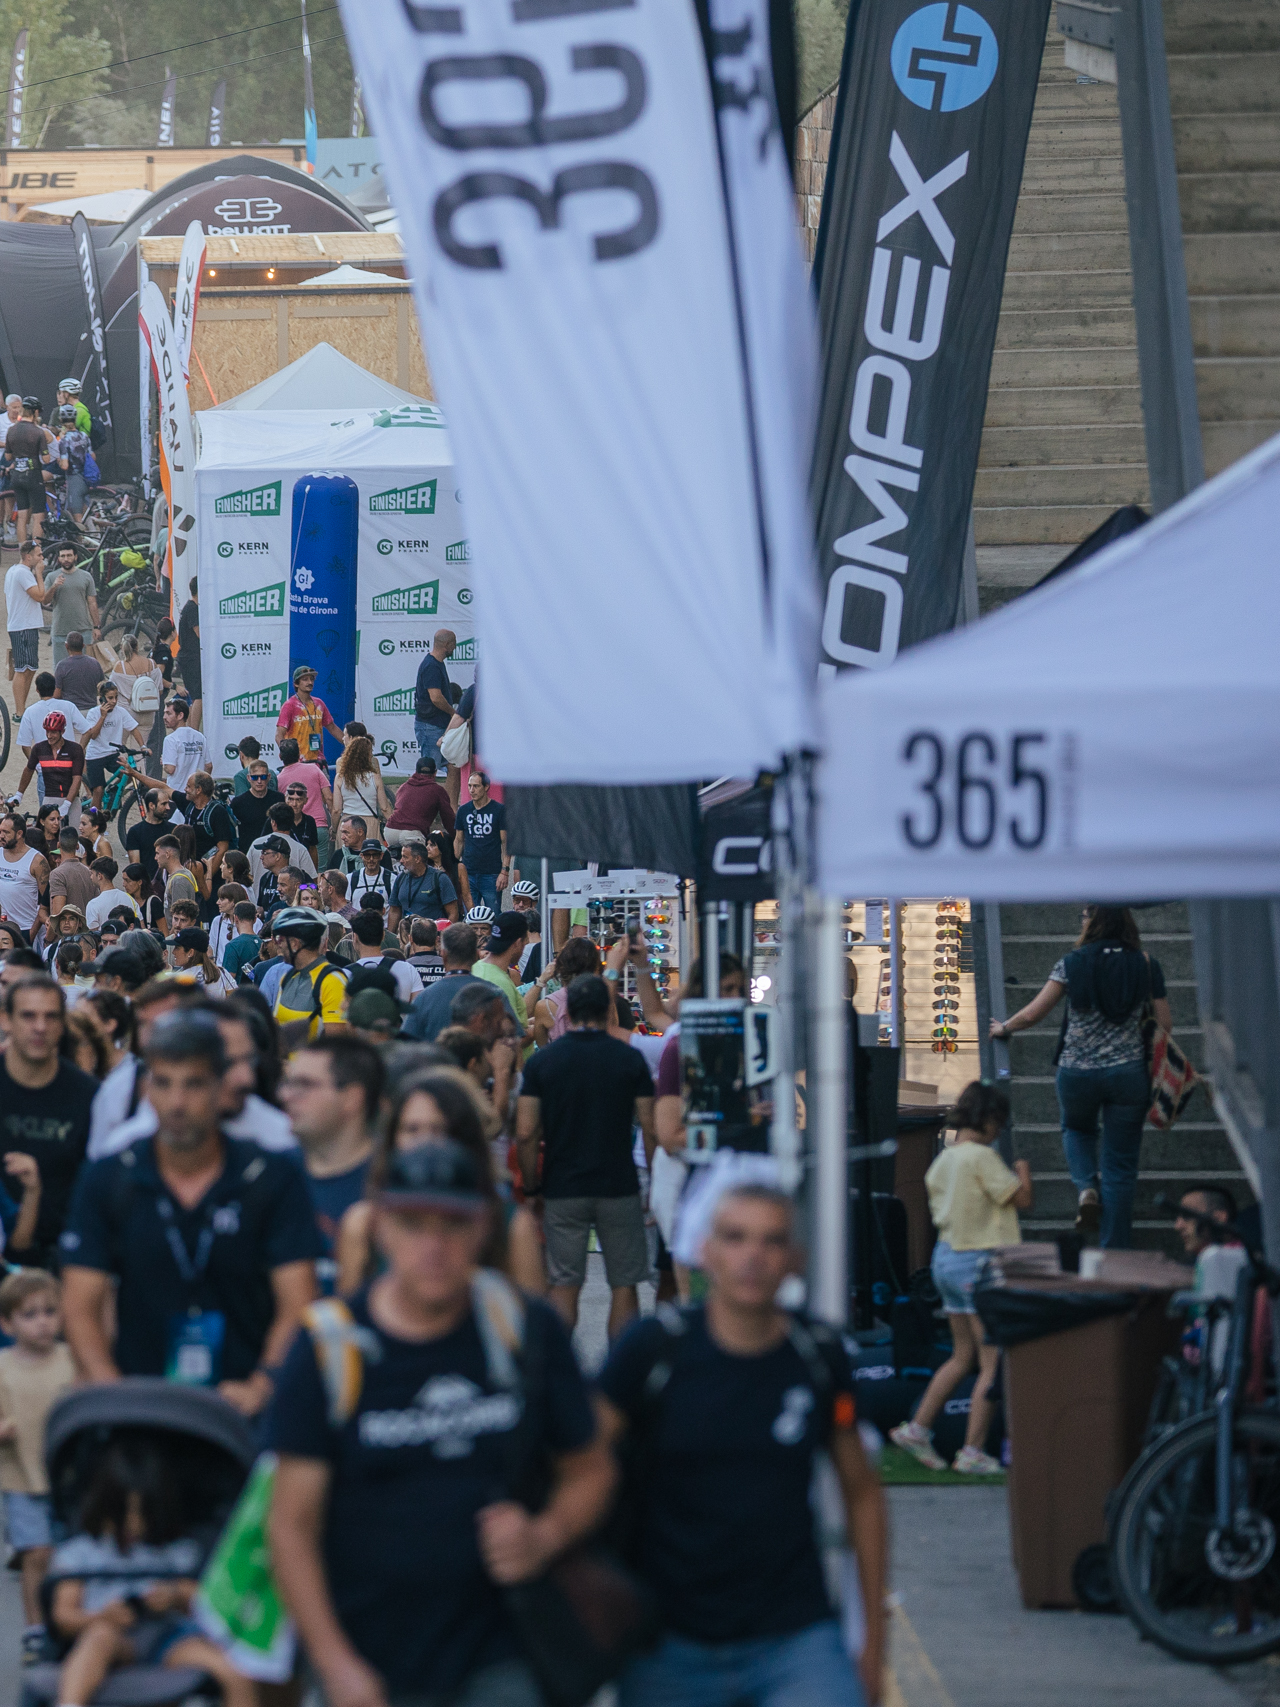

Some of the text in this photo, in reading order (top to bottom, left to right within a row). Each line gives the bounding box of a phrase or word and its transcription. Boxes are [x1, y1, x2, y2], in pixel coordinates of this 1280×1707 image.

[819, 130, 969, 678] OMPEX
[216, 487, 278, 513] FINISHER
[371, 486, 432, 511] FINISHER
[238, 542, 269, 550] KERN
[398, 540, 429, 548] KERN
[220, 588, 281, 614] FINISHER
[303, 594, 328, 604] Brava
[373, 586, 434, 611] FINISHER
[309, 606, 338, 615] Girona
[241, 643, 272, 651] KERN
[399, 640, 430, 649] KERN
[224, 689, 283, 716] FINISHER
[899, 729, 1051, 852] 365
[466, 813, 493, 825] CAN
